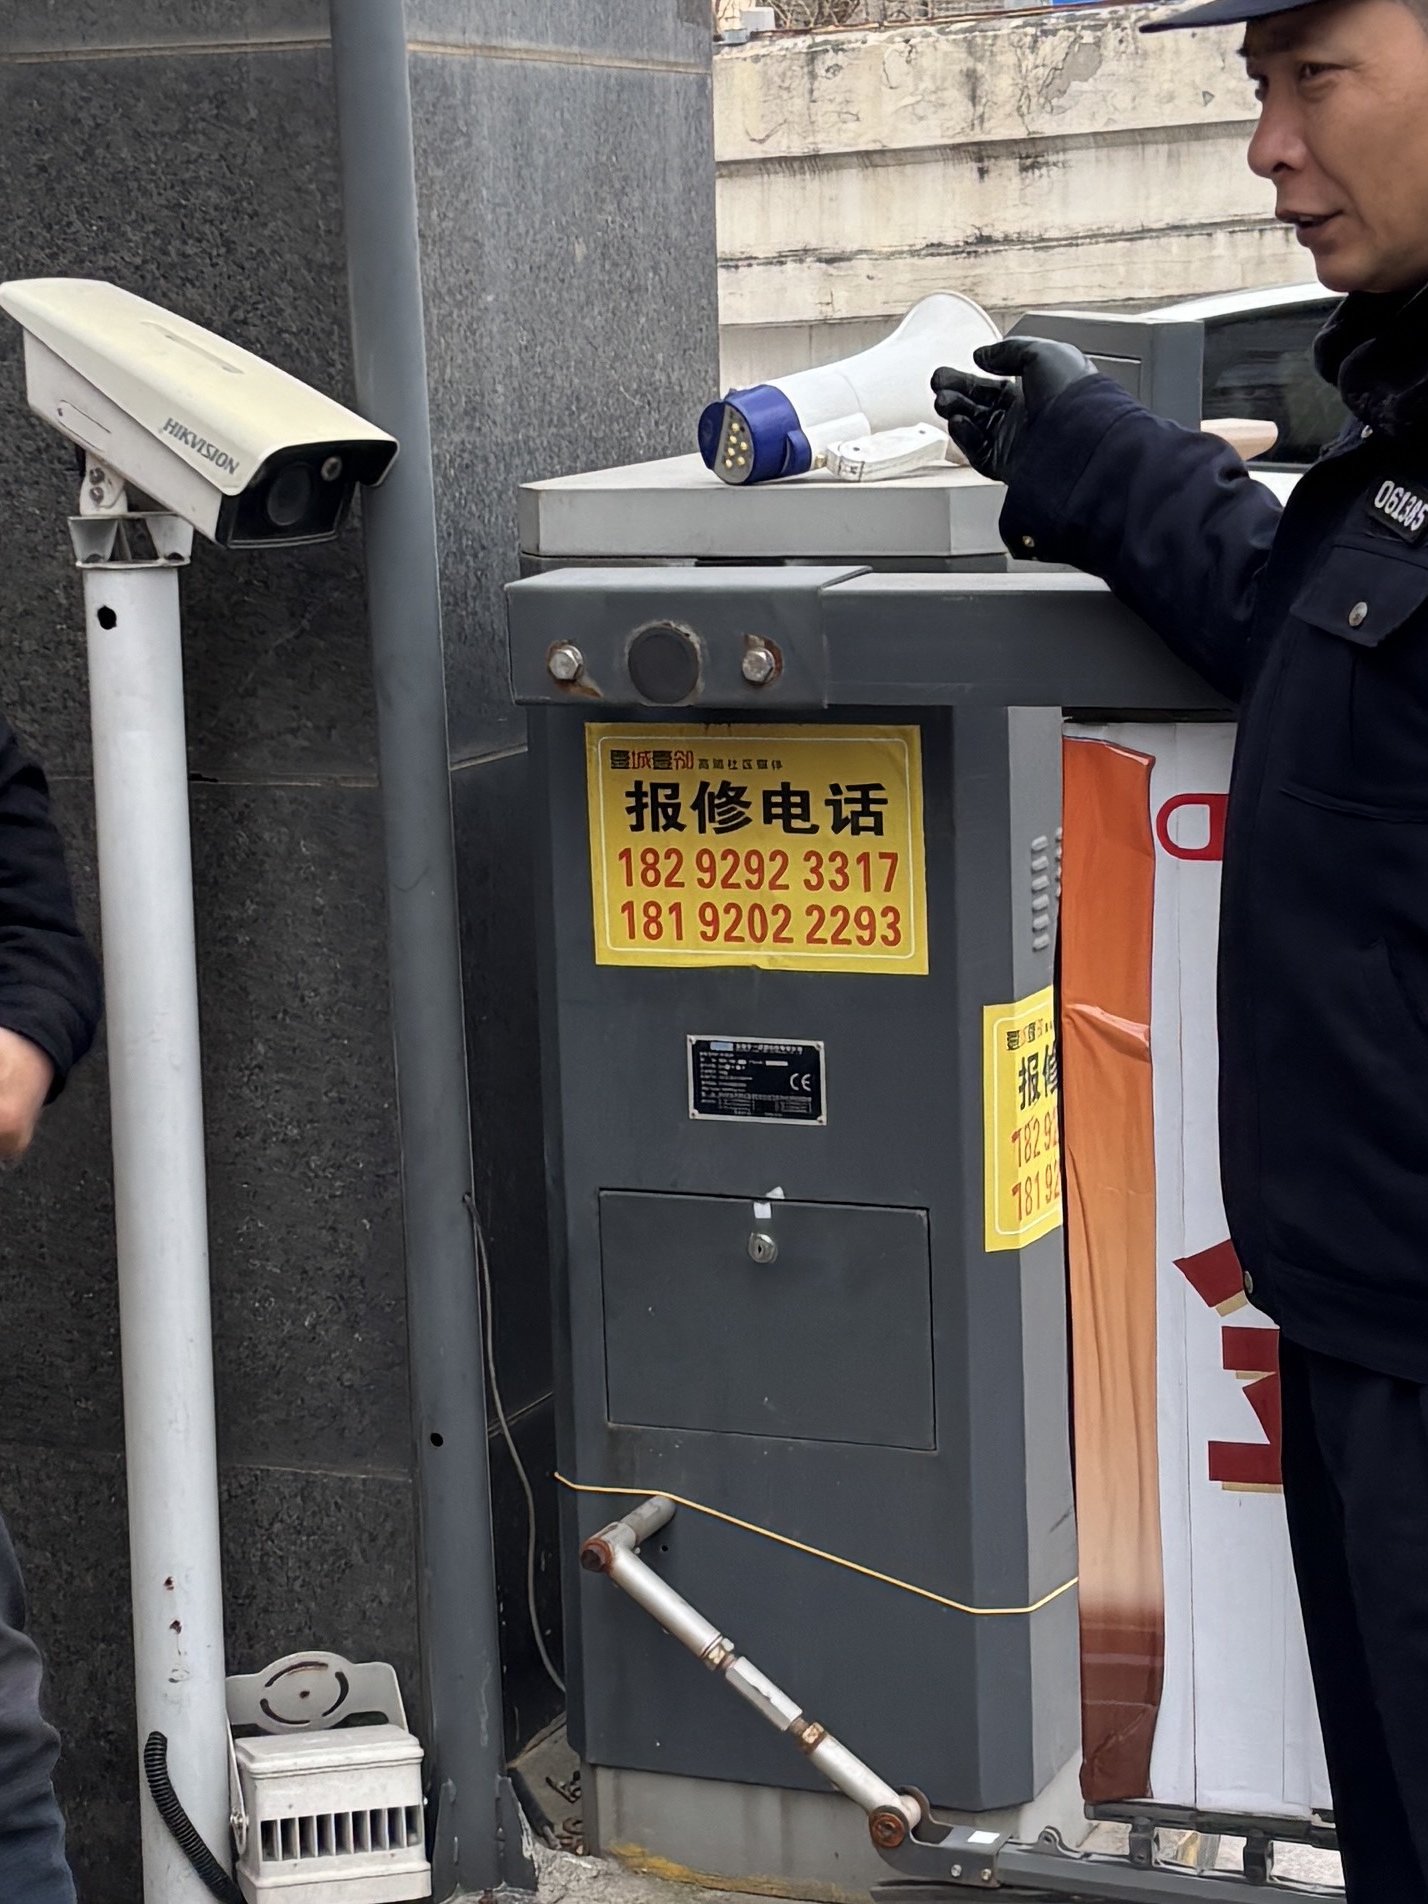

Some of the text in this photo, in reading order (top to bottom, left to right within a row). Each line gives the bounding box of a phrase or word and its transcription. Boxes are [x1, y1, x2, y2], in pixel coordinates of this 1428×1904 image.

[162, 417, 240, 475] HIKVISION
[625, 779, 888, 836] 报修电话
[618, 847, 899, 893] 182 9292 3317
[621, 900, 901, 947] 181 9202 2293
